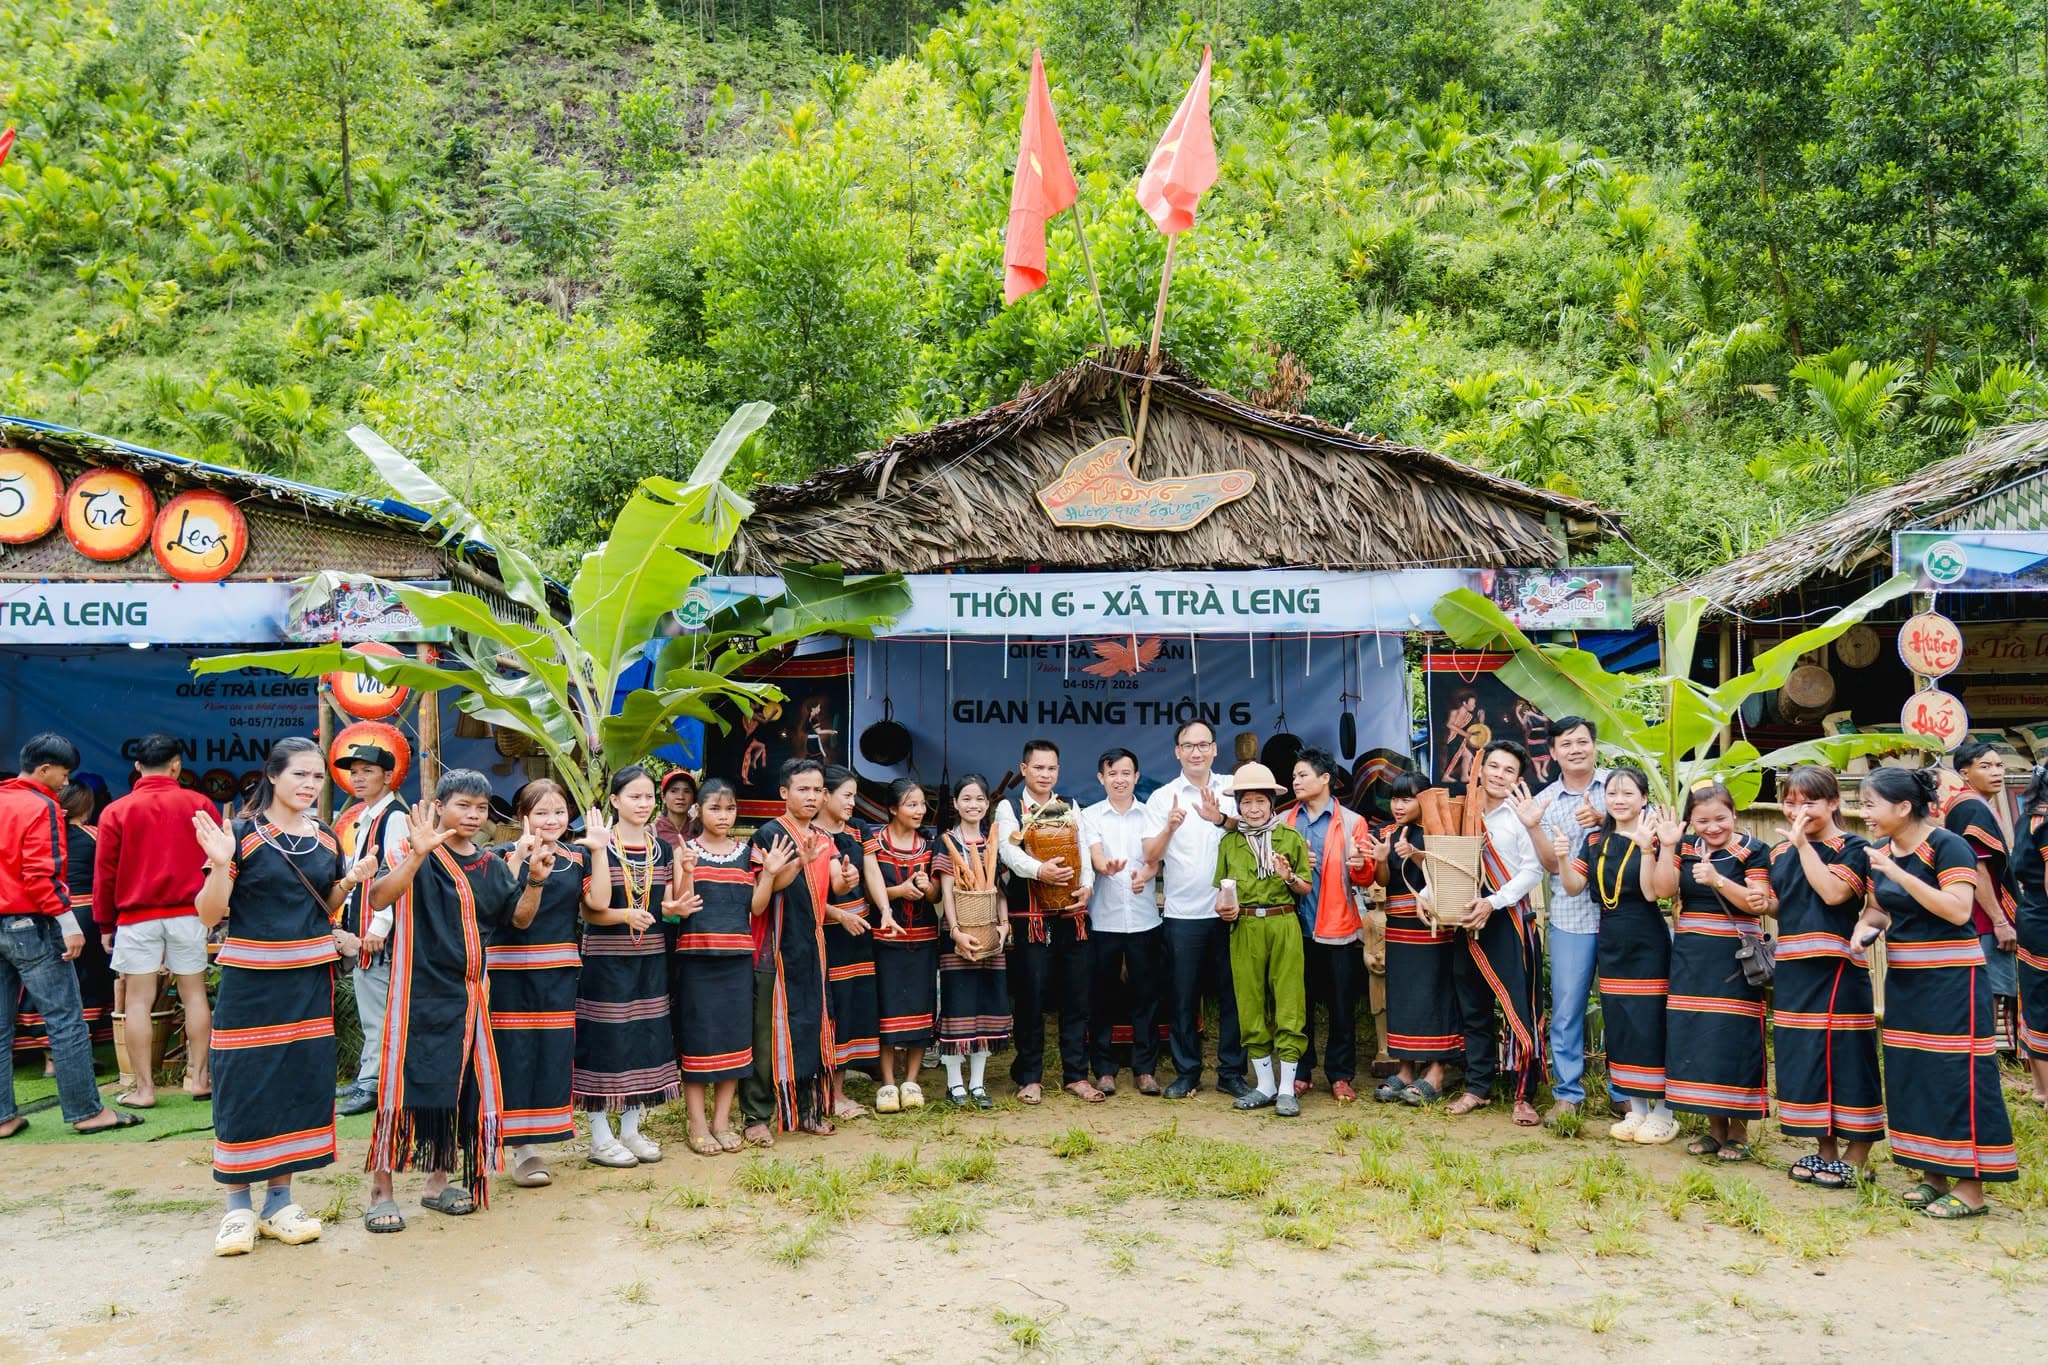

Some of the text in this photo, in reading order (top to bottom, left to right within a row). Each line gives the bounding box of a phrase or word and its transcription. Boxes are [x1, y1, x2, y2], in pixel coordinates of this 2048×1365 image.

[79, 487, 140, 530] Trà
[166, 509, 230, 568] Leng
[64, 602, 147, 626] LENG
[949, 586, 1042, 617] THÔN
[1051, 592, 1075, 617] 6
[1102, 584, 1149, 616] XÃ
[1155, 584, 1224, 615] TRÀ
[1232, 589, 1320, 615] LENG
[176, 678, 218, 697] QUẾ
[221, 680, 255, 697] TRÀ
[261, 683, 309, 697] LENG
[230, 717, 305, 729] 04-05/7/2026
[953, 695, 1251, 725] GIAN HÀNG THÔN 6
[121, 733, 278, 762] GN HÀN
